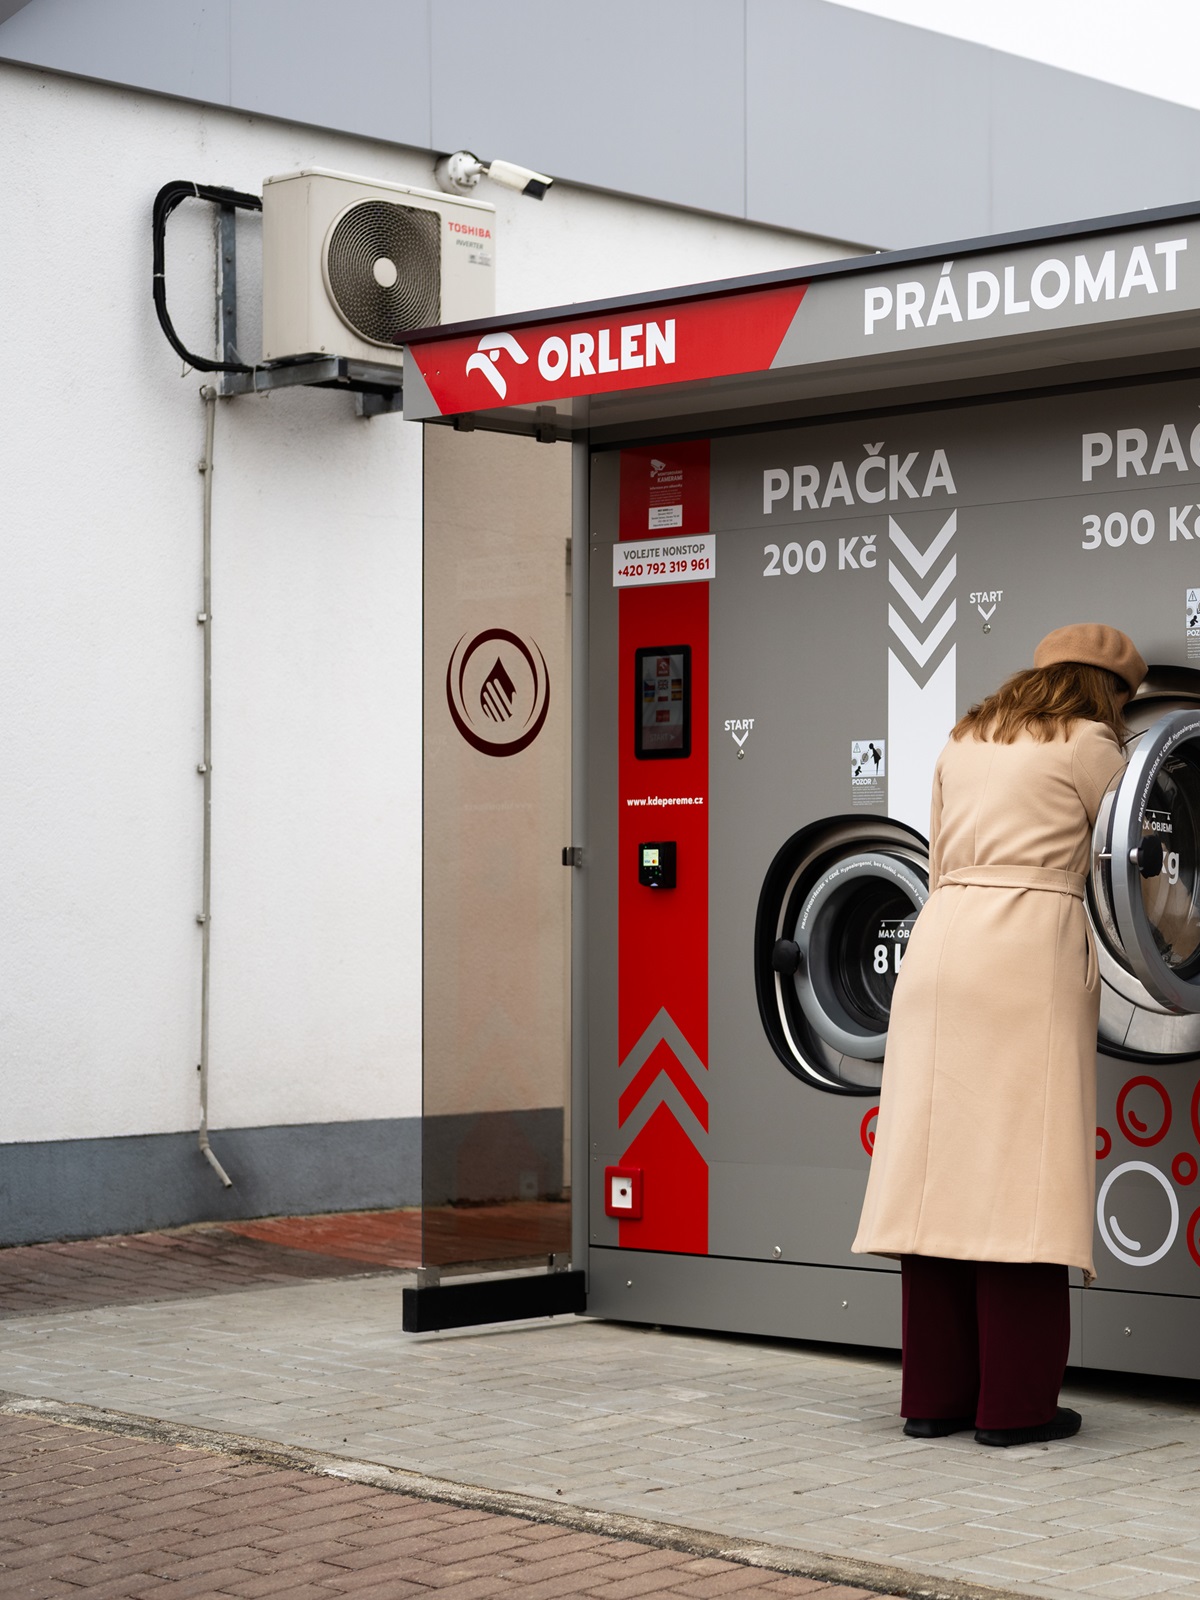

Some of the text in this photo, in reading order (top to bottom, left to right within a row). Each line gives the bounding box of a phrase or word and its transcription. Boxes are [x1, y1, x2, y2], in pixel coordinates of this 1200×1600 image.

[448, 222, 491, 239] TOSHIBA
[456, 240, 483, 249] INVERTER
[863, 238, 1187, 336] PRÁDLOMAT
[538, 319, 675, 381] ORLEN
[763, 442, 957, 514] PRAČKA
[1082, 510, 1156, 550] 300
[623, 544, 705, 560] VOLEJTE NONSTOP
[763, 535, 877, 576] 200 Kč
[618, 558, 709, 577] +420 792 319 961
[968, 590, 1003, 604] START
[724, 719, 754, 731] START
[852, 778, 872, 786] POZOR
[1138, 797, 1146, 822] PRACÍ
[1142, 756, 1160, 798] PROSTŘEDEK
[627, 796, 703, 807] www.kdepereme.cz
[801, 911, 809, 930] PRACÍ
[878, 929, 896, 938] MAX
[873, 944, 889, 974] 8
